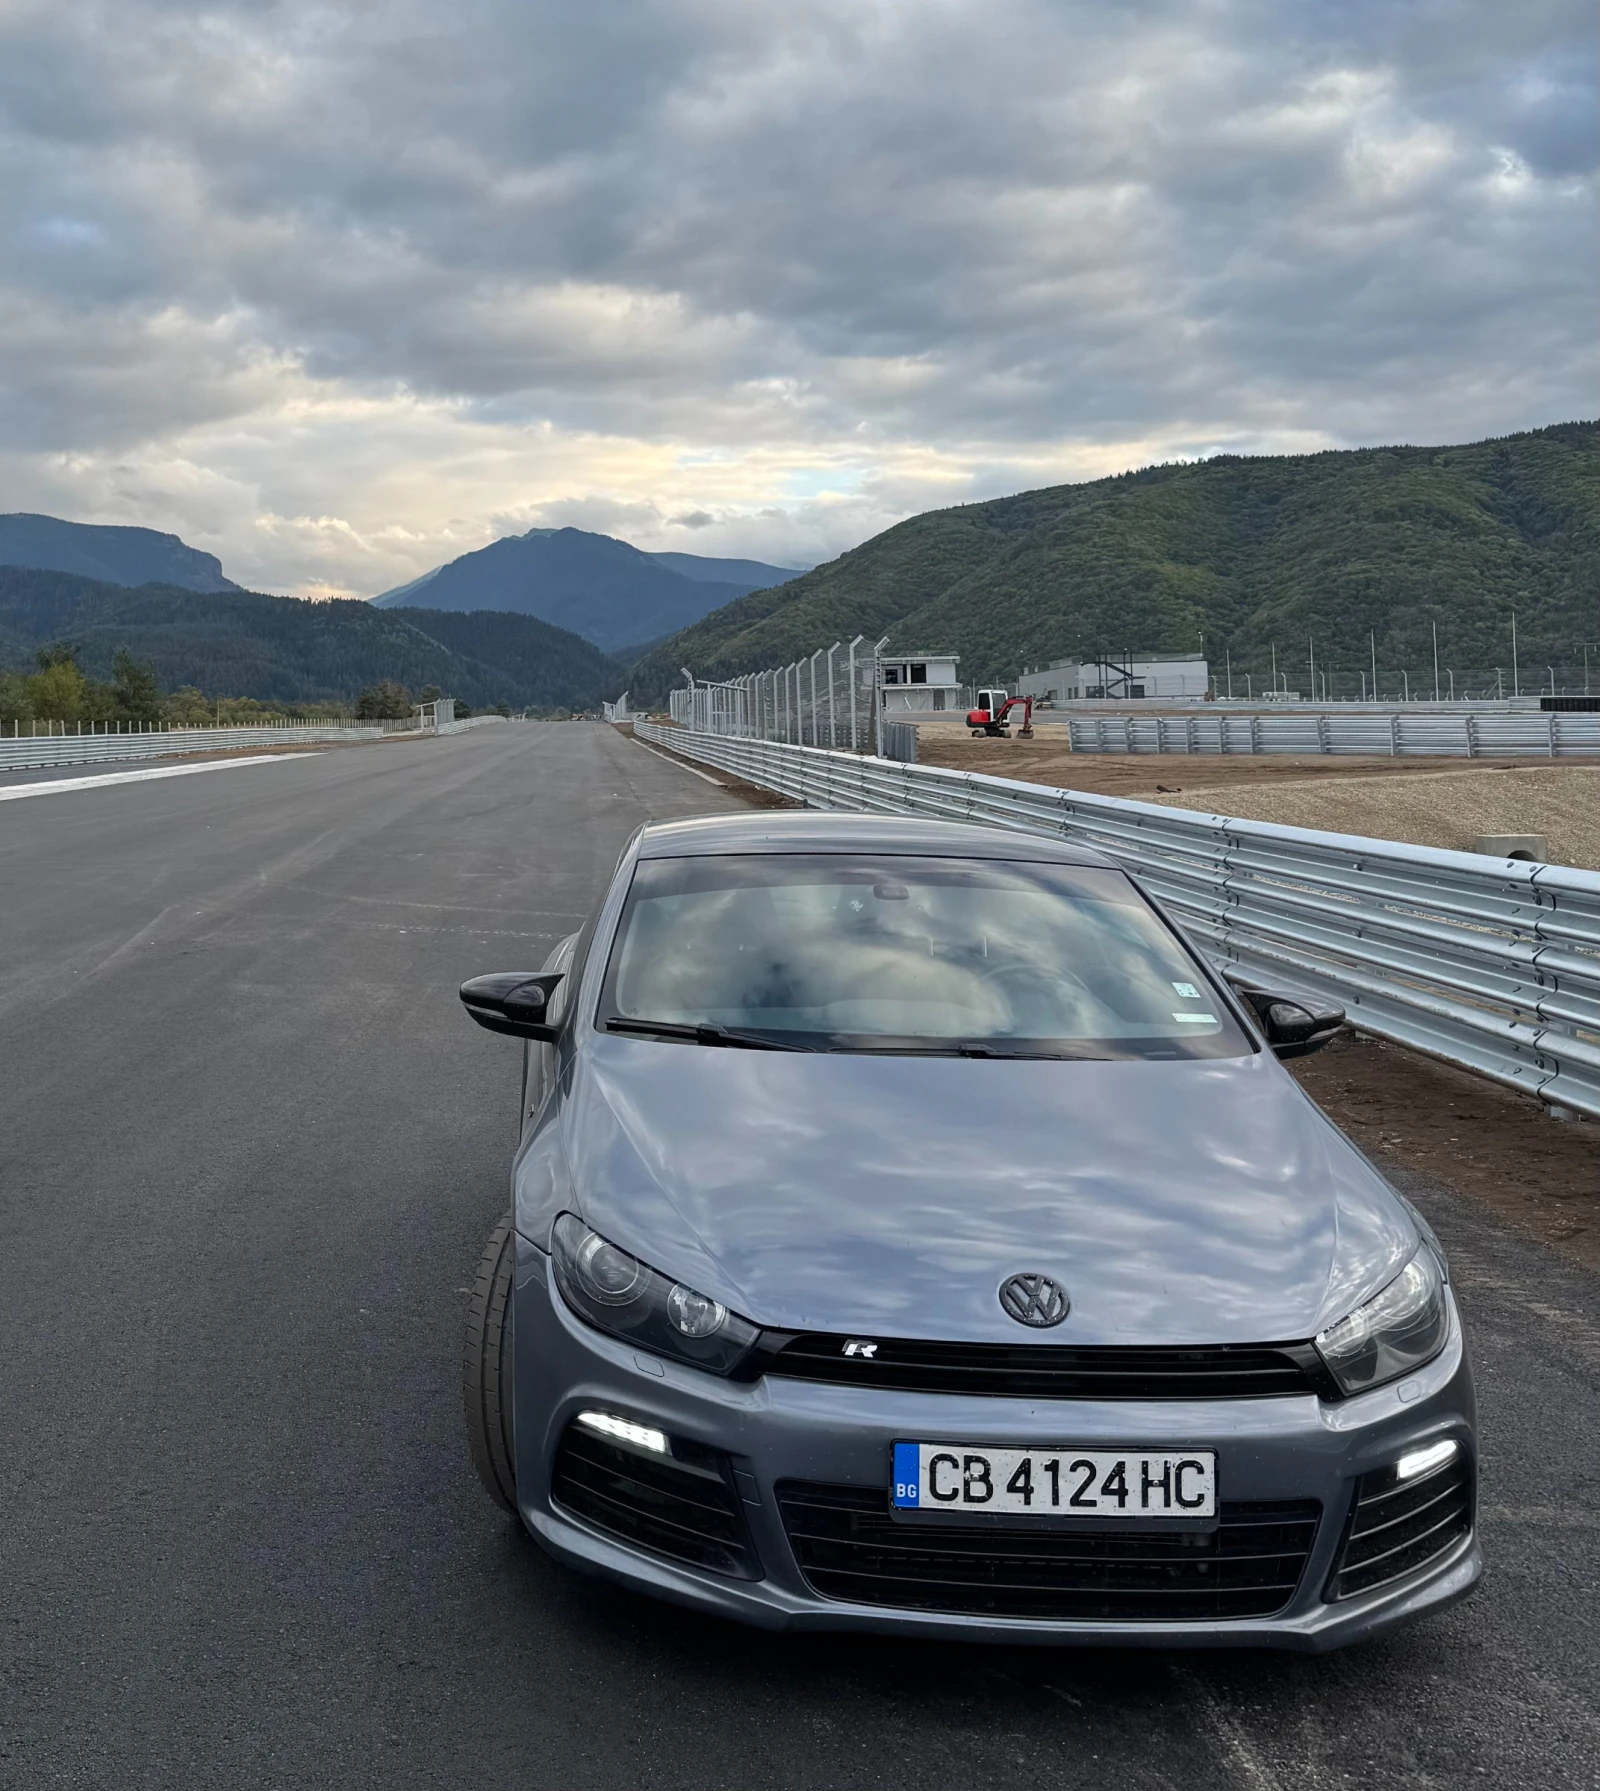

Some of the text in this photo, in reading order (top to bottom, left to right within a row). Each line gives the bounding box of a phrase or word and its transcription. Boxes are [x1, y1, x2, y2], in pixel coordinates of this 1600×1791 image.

[1001, 1273, 1069, 1327] VW
[842, 1339, 878, 1358] R
[896, 1483, 917, 1498] BG
